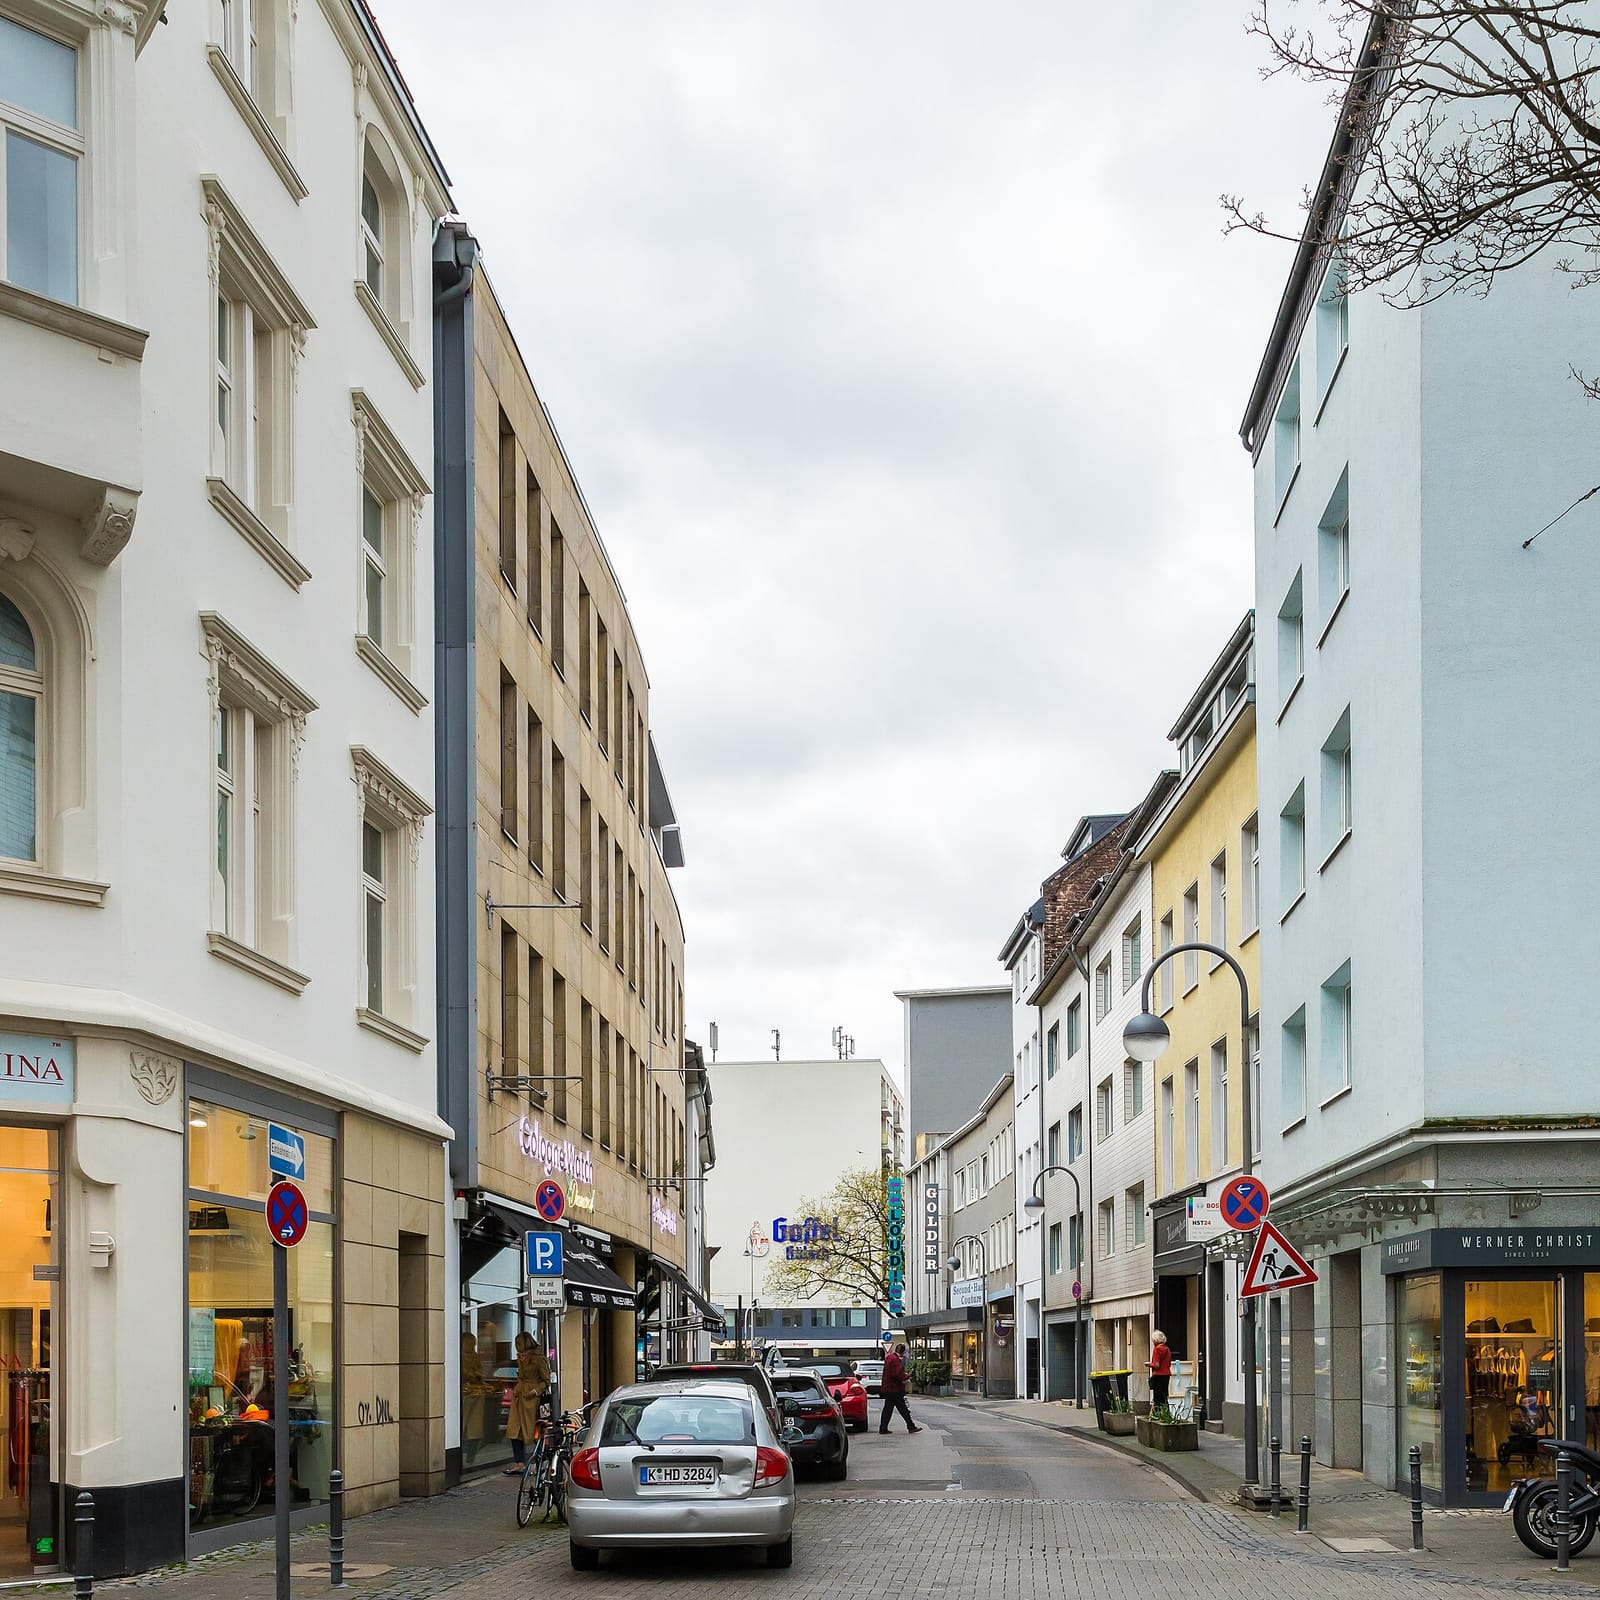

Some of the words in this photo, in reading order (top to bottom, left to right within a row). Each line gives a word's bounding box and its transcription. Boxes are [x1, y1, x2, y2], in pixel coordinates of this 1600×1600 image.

[0, 1052, 64, 1081] INA
[926, 1187, 938, 1270] GOLDER
[1462, 1235, 1524, 1248] WERNER
[1536, 1234, 1593, 1247] CHRIST
[648, 1468, 655, 1481] K
[664, 1468, 680, 1481] HD
[684, 1468, 712, 1481] 3284
